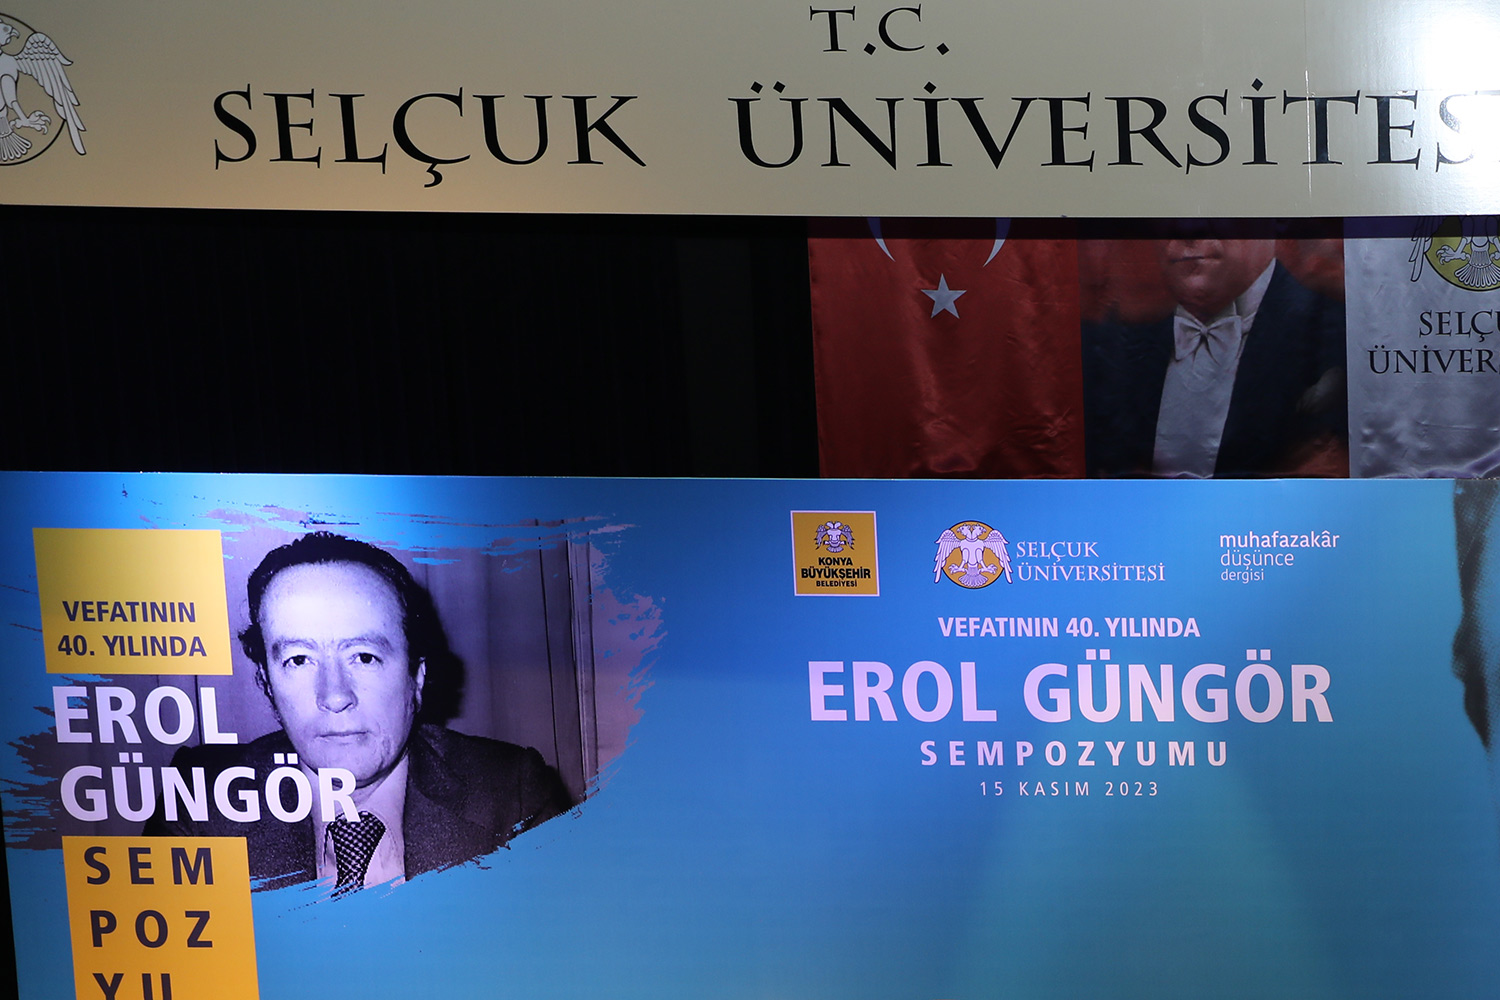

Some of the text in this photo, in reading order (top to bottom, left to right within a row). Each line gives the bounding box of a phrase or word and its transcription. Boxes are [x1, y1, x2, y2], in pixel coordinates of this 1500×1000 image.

[810, 5, 949, 56] T.C.
[213, 83, 647, 188] SELÇUK
[1219, 530, 1340, 548] muhafazakâr
[818, 557, 853, 566] KONYA
[1016, 541, 1100, 562] SELÇUK
[1220, 549, 1295, 571] düşünce
[801, 566, 871, 580] BÜYÜKŞEHİR
[1017, 562, 1166, 582] ÜNİVERSİTESİ
[1220, 568, 1265, 584] dergisi
[816, 579, 858, 587] BELEDİYESİ
[62, 600, 196, 623] VEFATININ
[938, 617, 1201, 638] VEFATININ 40. YILINDA
[57, 635, 207, 658] 40. YILINDA
[808, 648, 1334, 723] EROL GÜNGÖR
[52, 685, 238, 745] EROL
[920, 740, 1228, 767] SEMPOZYUMU
[59, 753, 361, 823] GÜNGÖR
[980, 781, 1160, 797] 15 KASIM 2023
